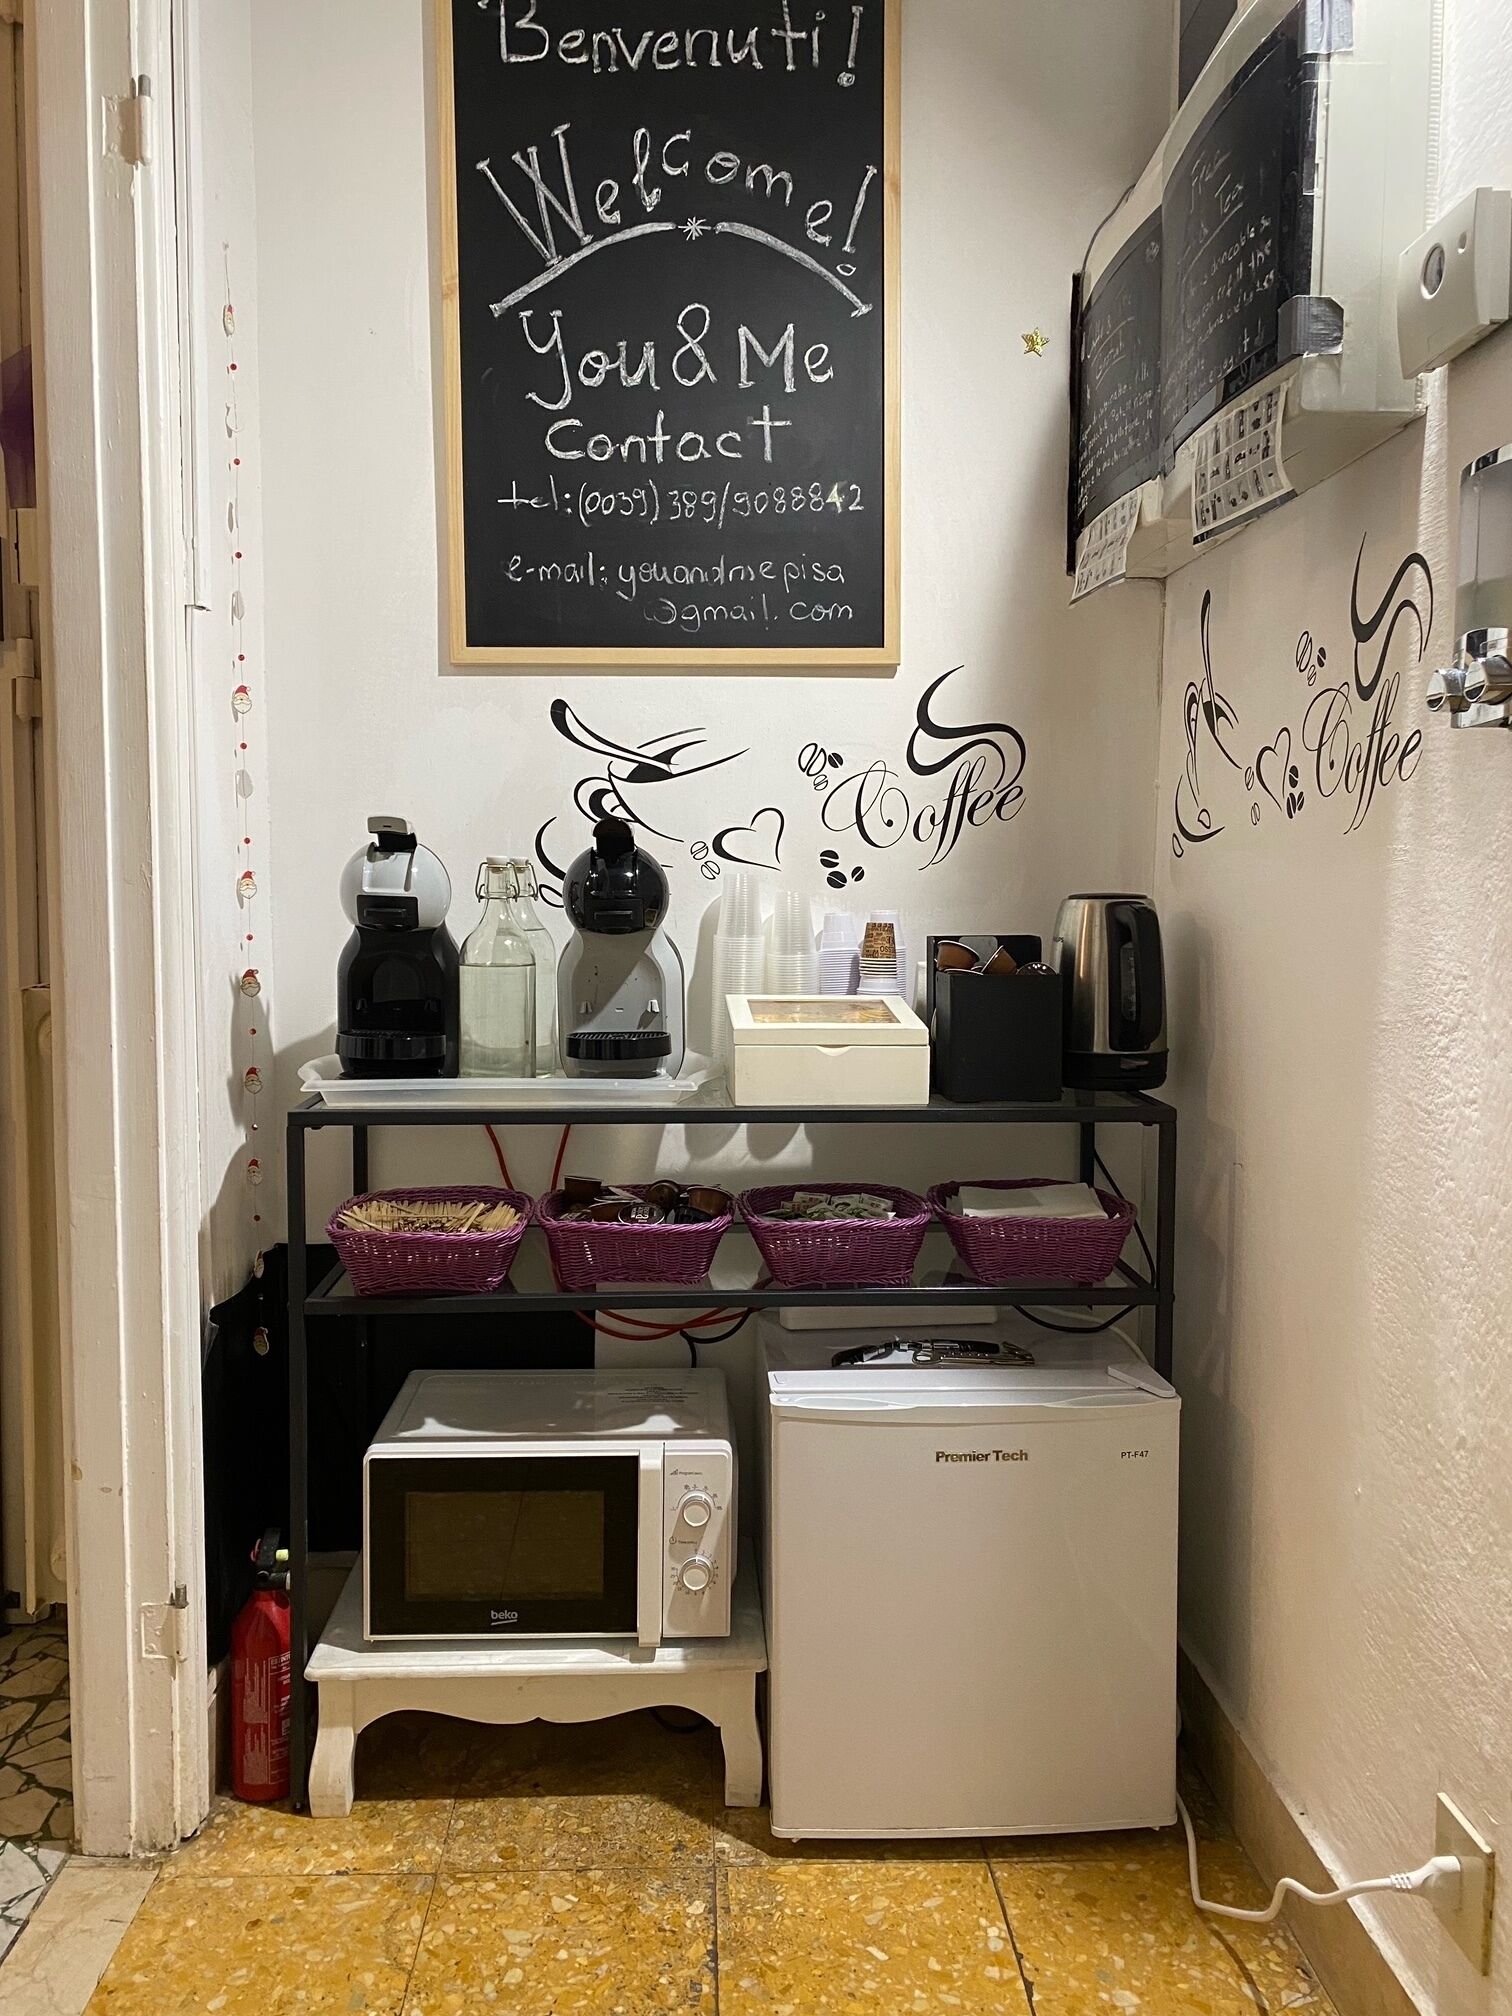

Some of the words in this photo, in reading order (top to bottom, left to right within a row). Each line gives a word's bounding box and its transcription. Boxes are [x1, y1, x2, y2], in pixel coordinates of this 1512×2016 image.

[478, 0, 865, 87] Benvenuti!
[475, 122, 878, 276] Welcome!
[518, 310, 660, 410] You
[671, 303, 718, 387] &
[737, 323, 835, 393] Me
[1302, 672, 1424, 834] Coffee
[821, 755, 1027, 871] Coffee
[935, 1451, 990, 1463] Premier
[992, 1450, 1029, 1462] Tech
[1119, 1450, 1150, 1460] PT-F47
[490, 1610, 518, 1620] beko
